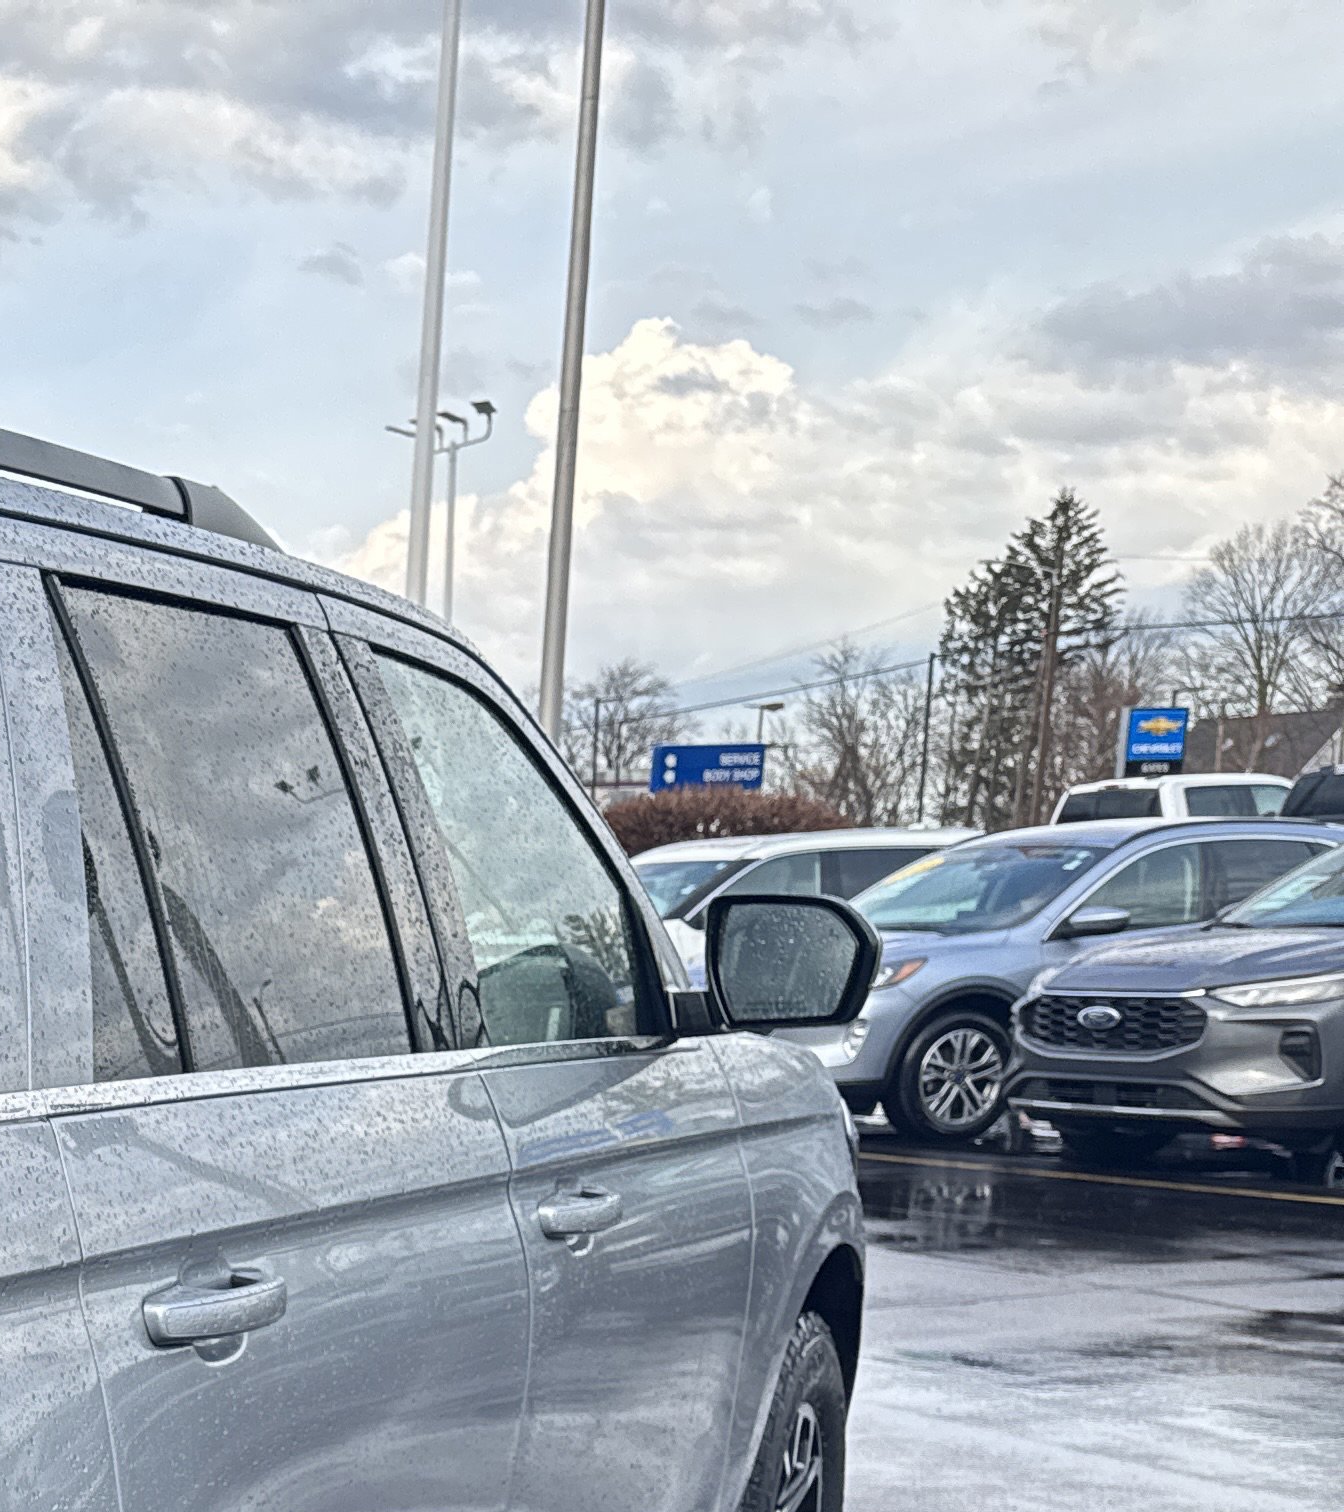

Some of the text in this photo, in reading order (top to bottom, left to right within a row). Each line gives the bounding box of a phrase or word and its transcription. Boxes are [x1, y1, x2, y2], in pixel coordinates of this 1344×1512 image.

[719, 752, 761, 766] SERVICE
[702, 767, 761, 782] BODY SHOP
